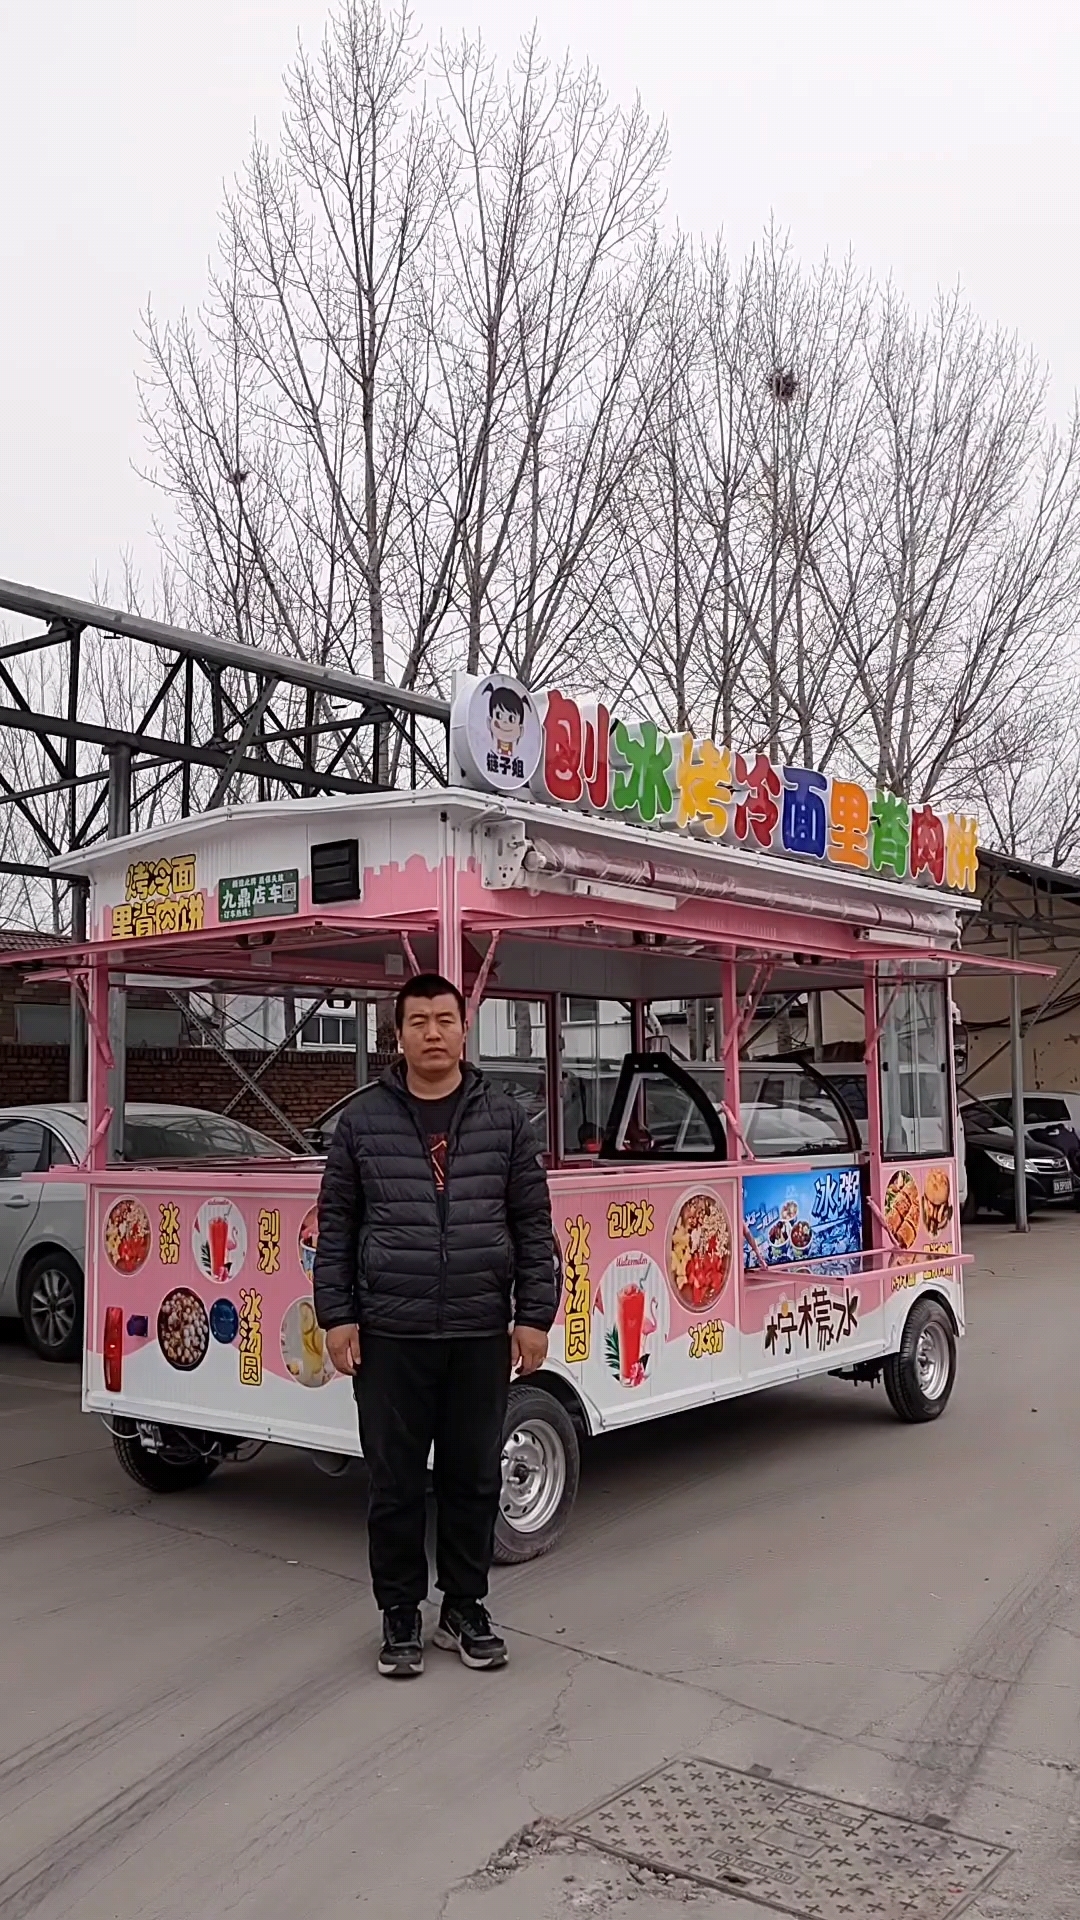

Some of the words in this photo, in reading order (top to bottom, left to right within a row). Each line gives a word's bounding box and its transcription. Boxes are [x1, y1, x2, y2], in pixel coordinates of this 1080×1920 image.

[543, 690, 978, 893] 刨冰烤冷面里脊肉饼
[125, 853, 197, 902] 烤冷面
[221, 883, 283, 910] 九鼎店车
[111, 892, 205, 940] 里脊肉饼
[606, 1199, 655, 1239] 刨冰
[811, 1168, 861, 1220] 冰粥
[158, 1201, 181, 1265] 冰粉
[256, 1208, 281, 1275] 刨冰
[564, 1215, 592, 1364] 冰汤圆
[238, 1288, 264, 1386] 冰汤圆
[688, 1318, 725, 1359] 冰粉
[764, 1287, 860, 1357] 柠檬水
